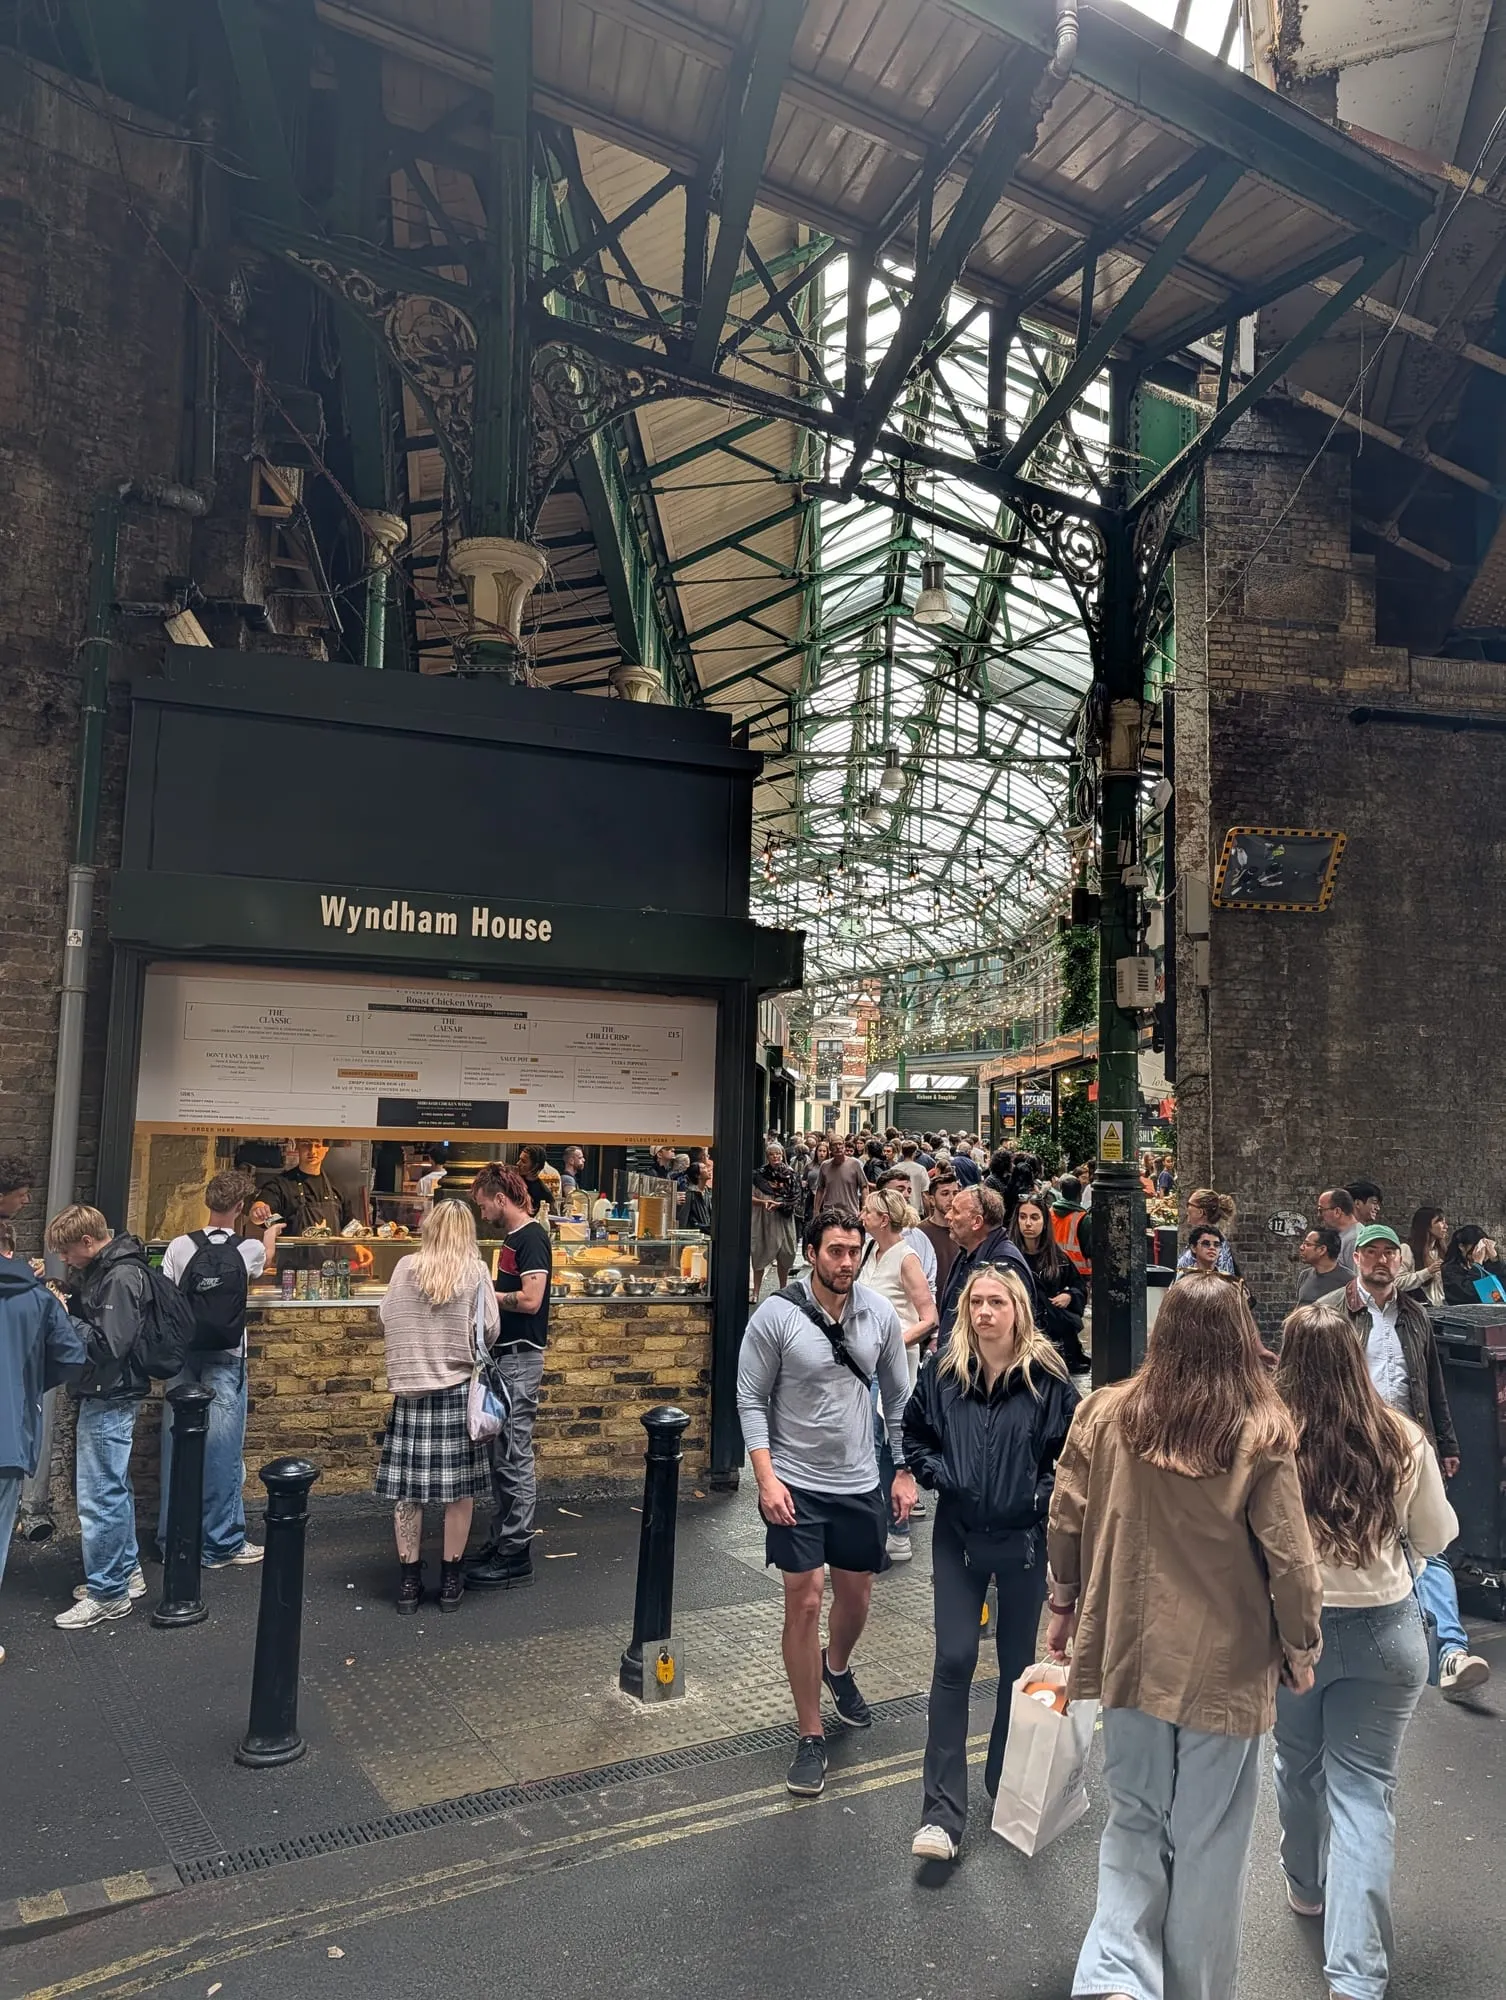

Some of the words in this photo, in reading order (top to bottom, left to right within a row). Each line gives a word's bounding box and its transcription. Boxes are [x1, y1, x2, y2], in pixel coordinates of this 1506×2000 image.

[320, 895, 458, 934] Wyndham
[472, 906, 552, 942] House
[406, 996, 430, 1005] Roast
[431, 996, 465, 1007] Chicken
[467, 998, 493, 1009] Wraps
[268, 1008, 285, 1016] THE
[258, 1016, 292, 1025] CLASSIC
[346, 1014, 360, 1023] £13
[433, 1025, 464, 1033] CAESAR
[513, 1023, 527, 1031] £14
[585, 1032, 609, 1040] CHILLI
[609, 1033, 630, 1041] CRISP
[667, 1031, 681, 1039] £15
[1274, 1220, 1284, 1231] 17
[200, 1277, 221, 1286] NIKE
